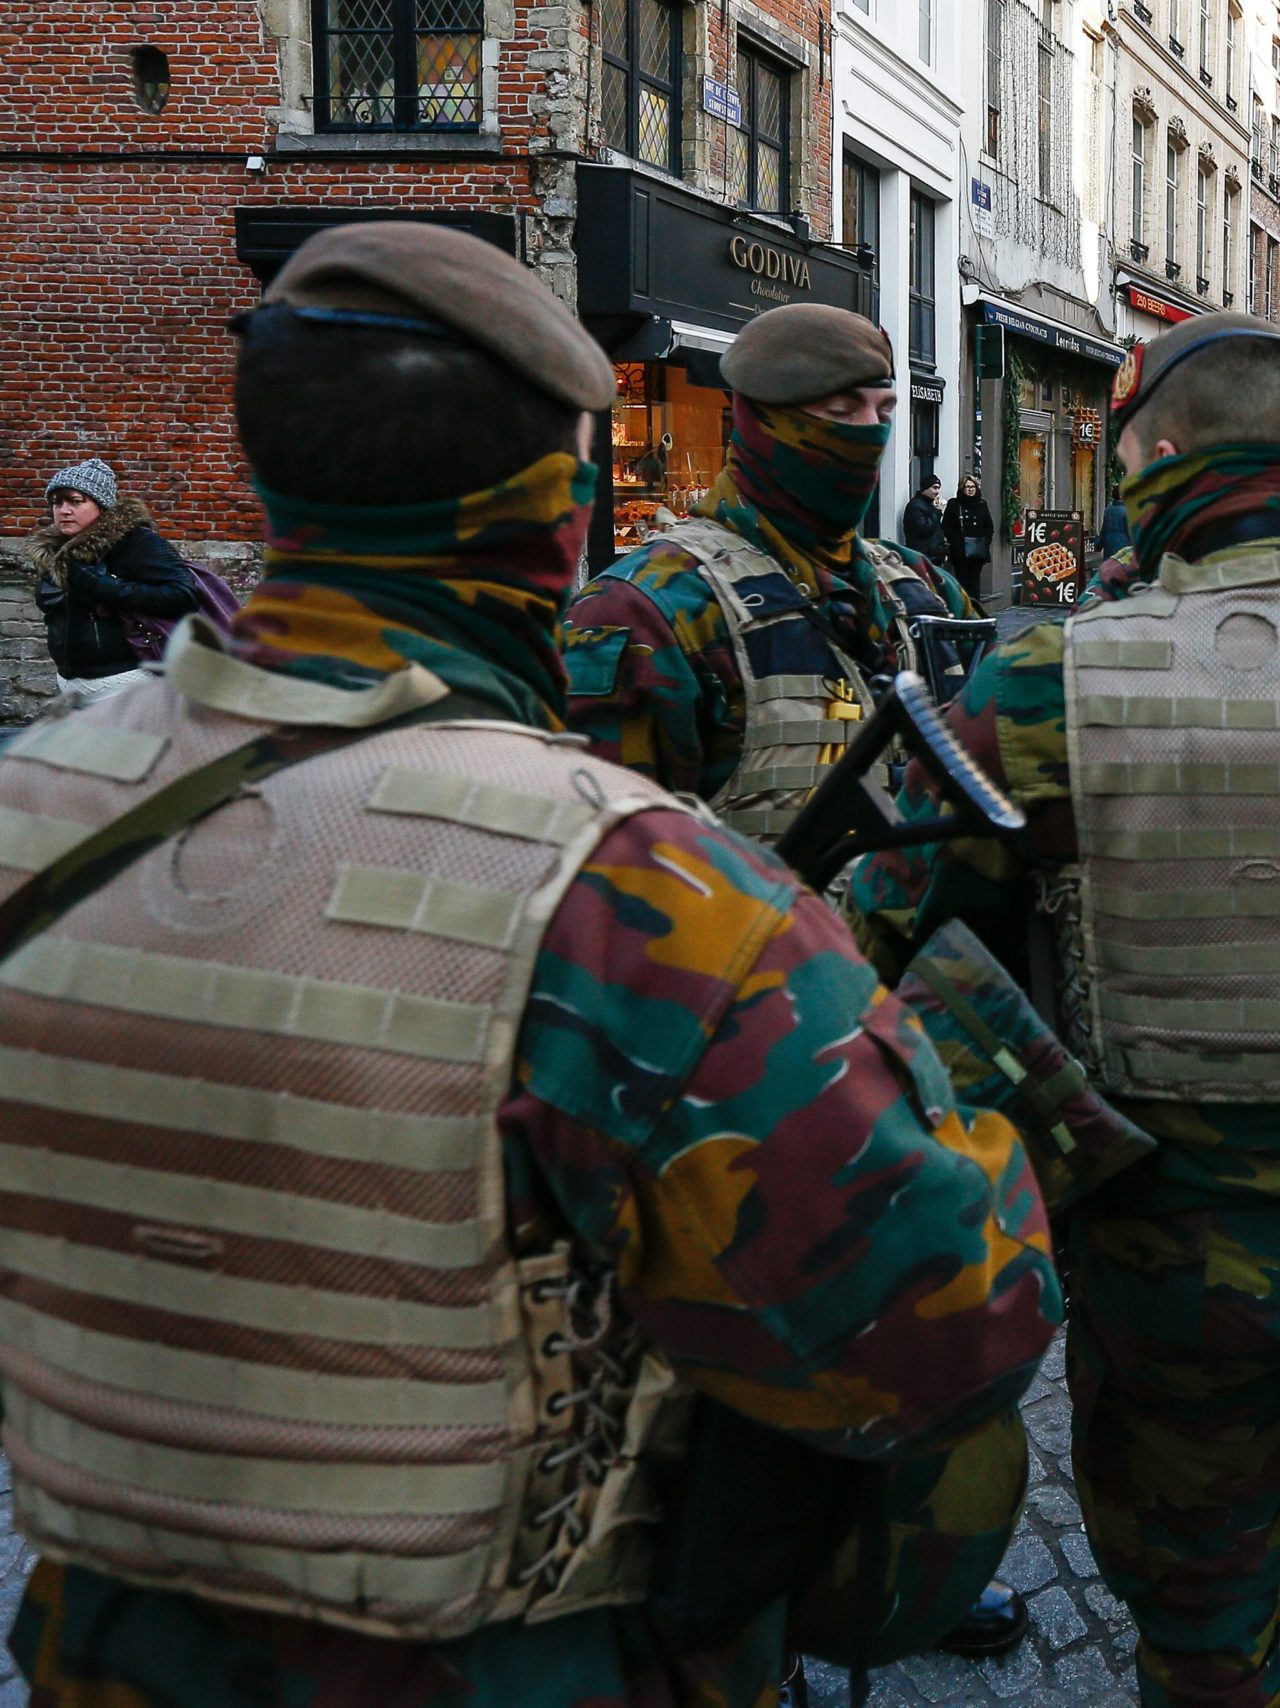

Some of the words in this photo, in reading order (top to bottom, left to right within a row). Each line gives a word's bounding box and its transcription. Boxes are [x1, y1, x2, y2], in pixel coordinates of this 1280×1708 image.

[730, 236, 812, 290] GODIVA
[751, 279, 791, 303] Chocolatier
[1147, 297, 1166, 315] BEERS
[1079, 423, 1093, 437] 1€
[1027, 521, 1047, 543] 1€
[1055, 581, 1076, 603] 1€
